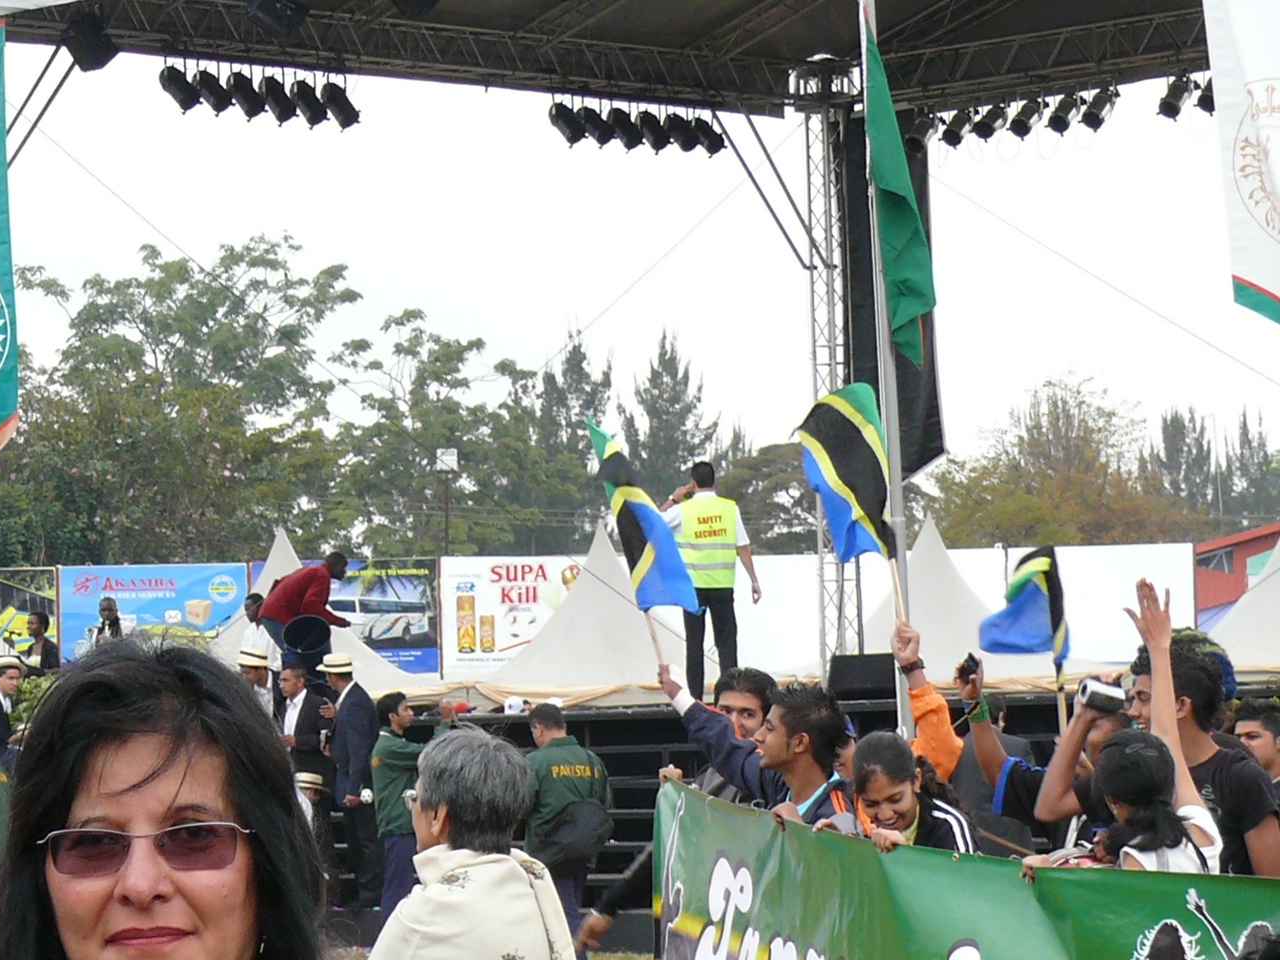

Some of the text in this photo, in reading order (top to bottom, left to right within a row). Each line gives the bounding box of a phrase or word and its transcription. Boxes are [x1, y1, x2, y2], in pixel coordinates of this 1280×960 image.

[697, 515, 722, 525] SAFETY
[694, 528, 727, 539] SECURITY
[490, 563, 548, 583] SUPA
[102, 576, 176, 590] AKAMBA
[501, 585, 539, 604] Kill
